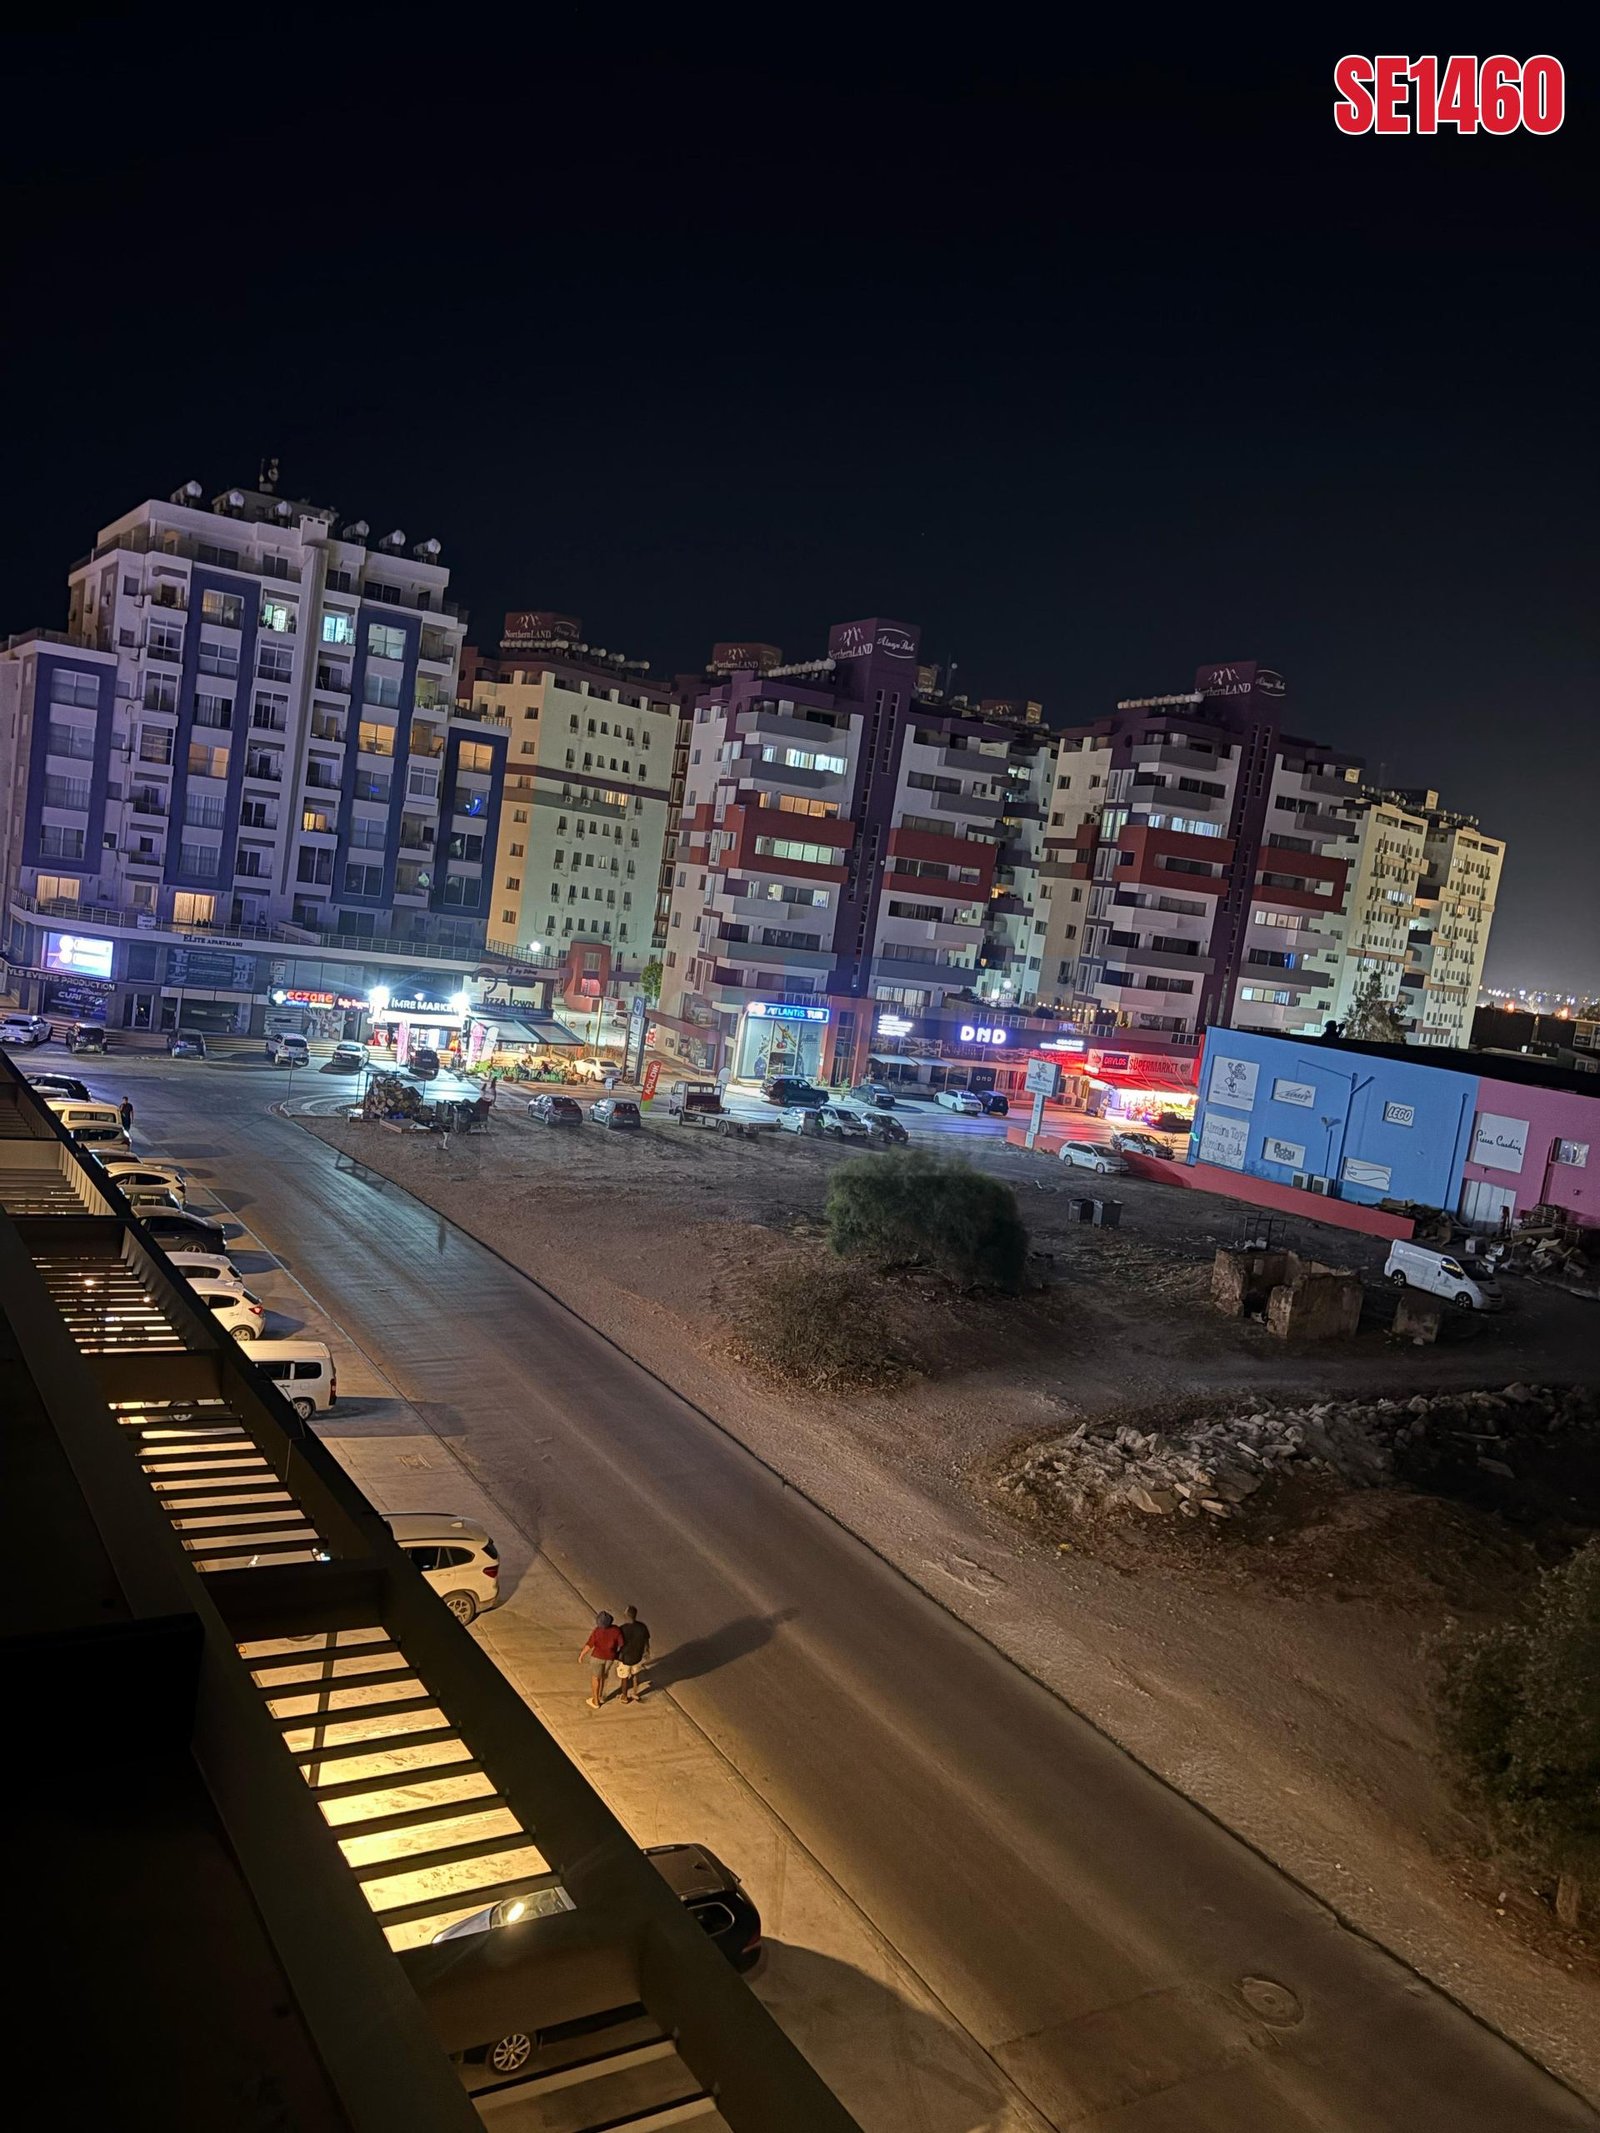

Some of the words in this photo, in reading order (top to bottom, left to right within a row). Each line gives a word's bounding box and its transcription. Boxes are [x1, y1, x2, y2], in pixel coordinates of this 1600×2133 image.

[61, 976, 115, 991] PRODUCTION
[286, 990, 333, 1003] eczane
[1387, 1105, 1413, 1122] LEGO
[1475, 1129, 1494, 1145] Pierre
[1496, 1135, 1522, 1156] Cardin
